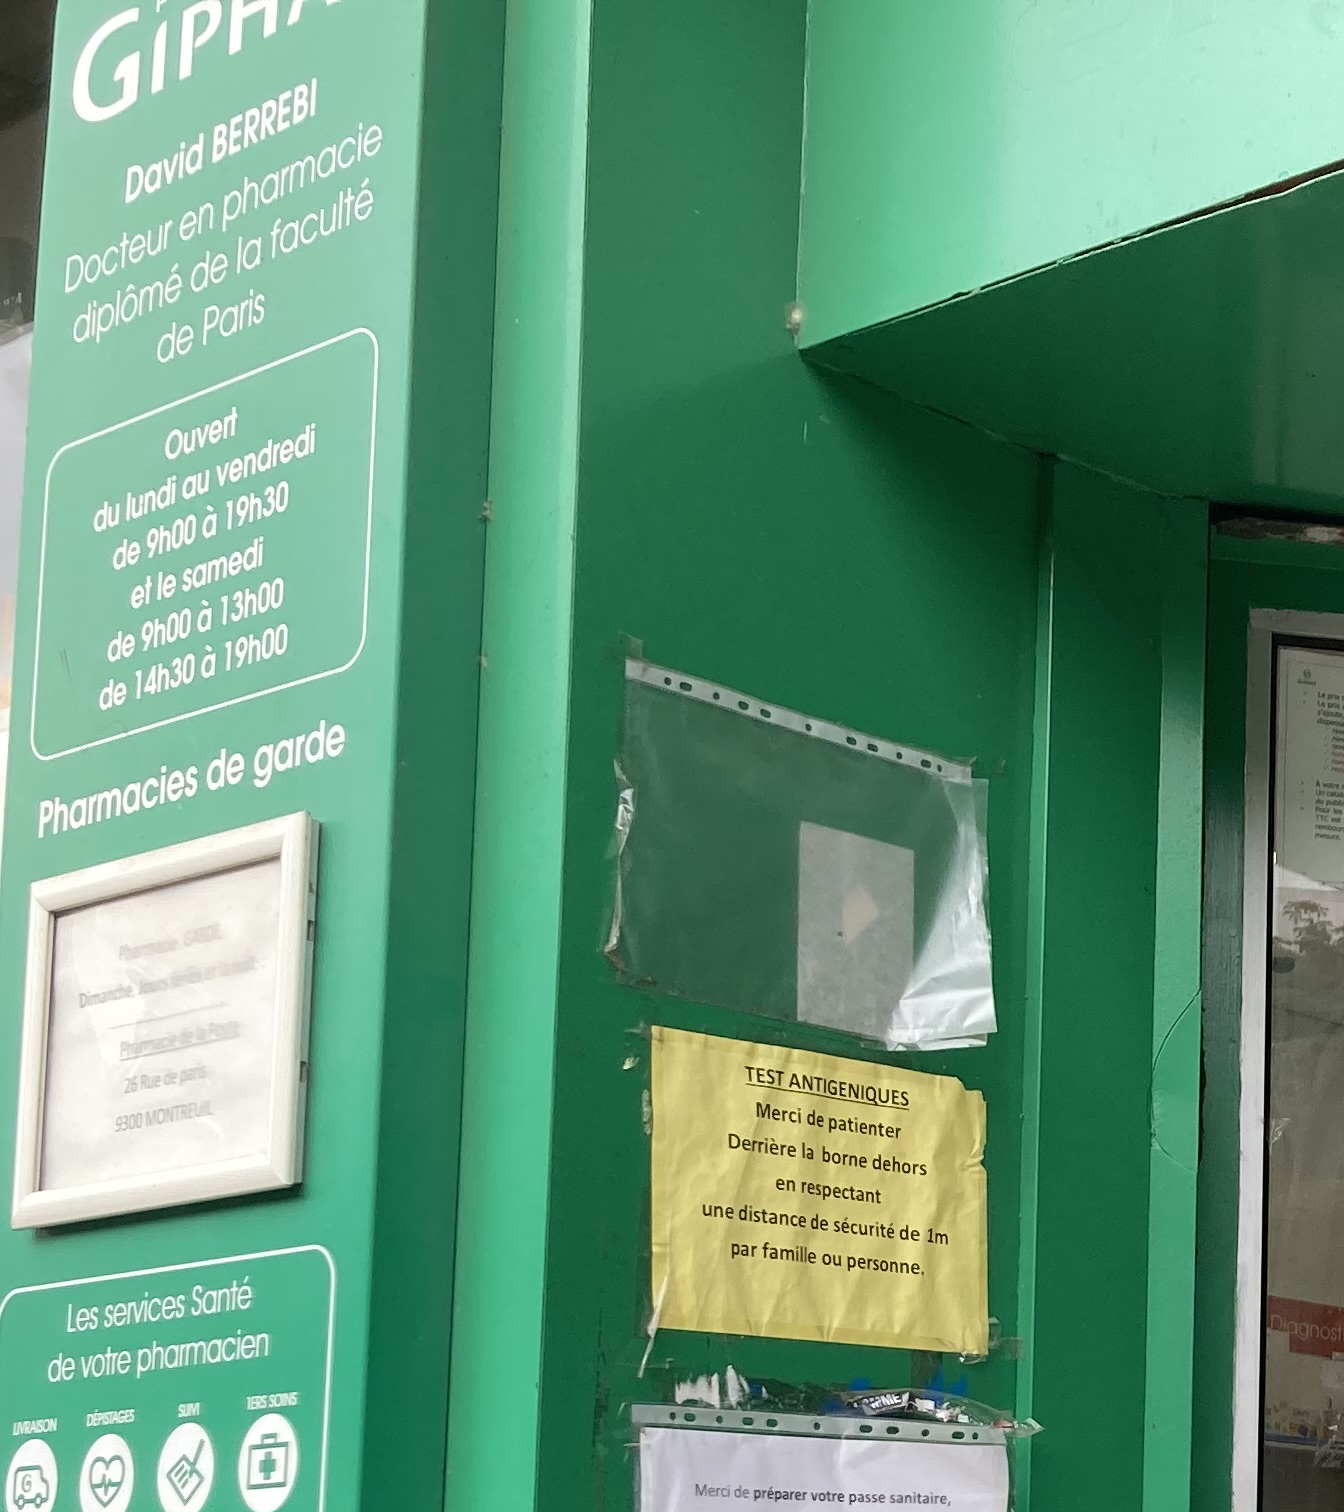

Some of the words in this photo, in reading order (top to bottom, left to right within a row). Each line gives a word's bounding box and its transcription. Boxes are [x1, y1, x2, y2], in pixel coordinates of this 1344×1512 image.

[125, 133, 204, 203] David
[211, 78, 317, 163] BERREBI
[64, 220, 172, 293] Docteur
[179, 202, 213, 241] en
[223, 123, 382, 231] pharmacie
[164, 407, 237, 460] Ouvert
[94, 502, 119, 532] du
[126, 476, 177, 522] lundi
[182, 469, 210, 499] au
[217, 423, 315, 484] vendredi
[38, 765, 197, 838] Pharmacies
[206, 748, 243, 792] de
[254, 719, 345, 787] garde
[745, 1065, 785, 1086] TEST
[789, 1073, 910, 1107] ANTIGENIQUES
[756, 1101, 802, 1124] Merci
[806, 1111, 825, 1129] de
[828, 1113, 902, 1140] patienter
[702, 1202, 734, 1220] une
[738, 1205, 807, 1229] distance
[810, 1214, 829, 1231] de
[833, 1216, 895, 1240] sécurité
[899, 1224, 920, 1242] de
[926, 1228, 949, 1246] 1m
[48, 1353, 76, 1383] de
[80, 1345, 131, 1379] votre
[137, 1329, 269, 1379] pharmacien
[13, 1418, 57, 1435] LIVRAISON
[86, 1408, 134, 1428] DÉPISTAGES
[695, 1483, 731, 1499] Merci
[734, 1485, 750, 1499] de
[753, 1486, 808, 1504] préparer
[810, 1490, 846, 1504] votre
[848, 1492, 887, 1507] passe
[889, 1490, 951, 1507] sanitaire,
